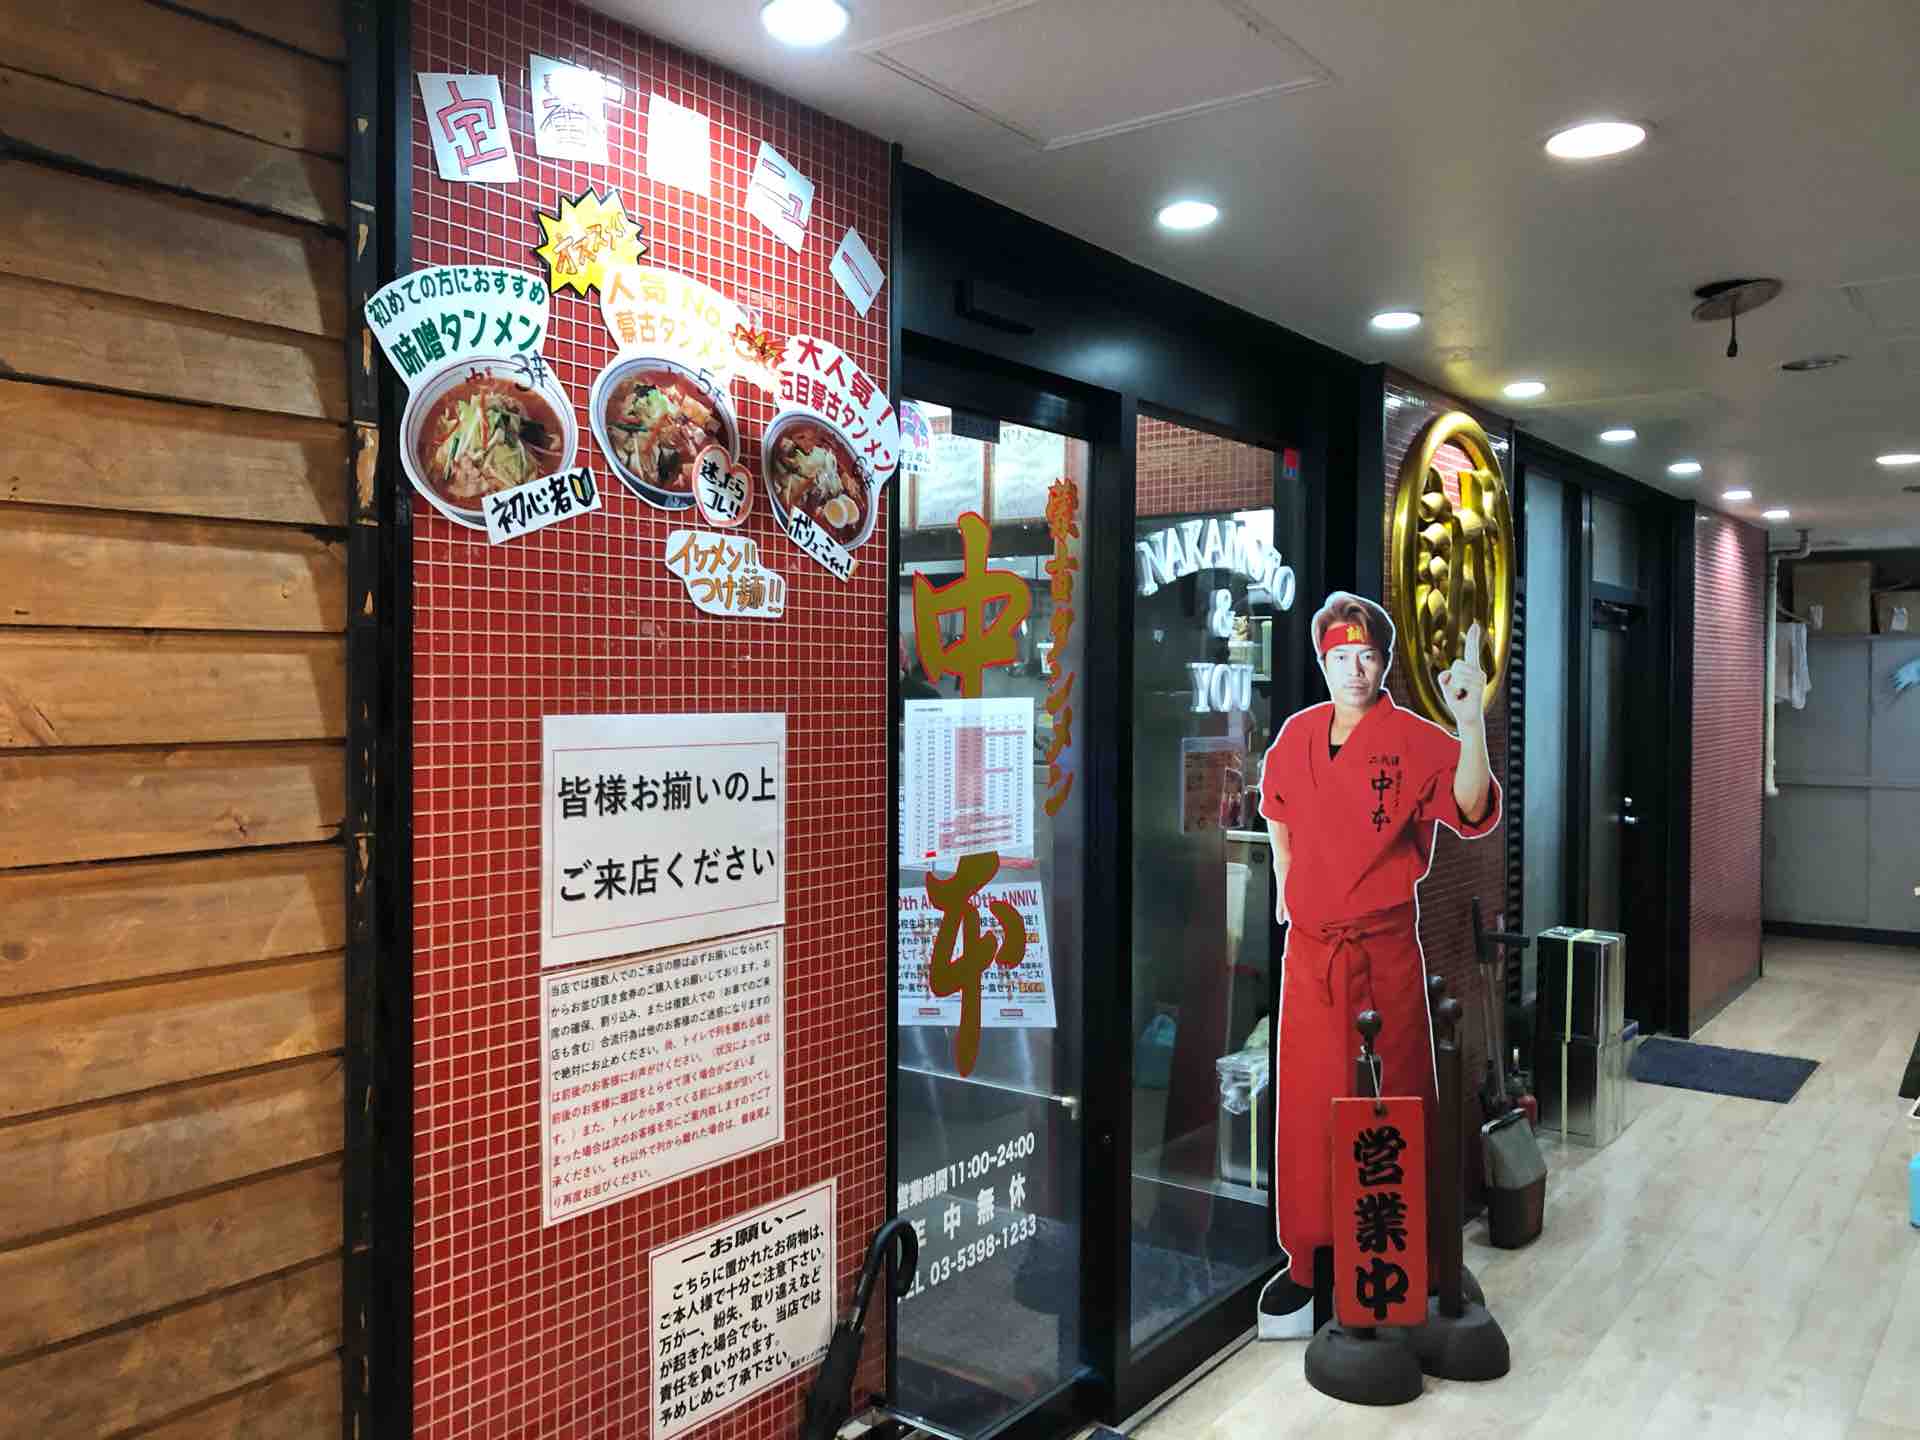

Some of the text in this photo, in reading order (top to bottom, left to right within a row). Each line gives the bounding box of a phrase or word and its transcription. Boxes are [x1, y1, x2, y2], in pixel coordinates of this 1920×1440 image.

[367, 268, 546, 329] 初めての方におすすめ
[390, 309, 542, 378] 味噌タンメン
[491, 476, 572, 534] 初心者
[1208, 588, 1236, 638] &
[1187, 662, 1254, 712] YOU
[557, 766, 776, 819] 皆様お揃いの上
[561, 846, 774, 902] ご来店ください
[930, 1214, 1036, 1286] 03-5398-1233
[1353, 1125, 1409, 1321] 営業中
[660, 1248, 825, 1330] ご本人様で十分ご注意下さい。
[673, 1224, 824, 1300] こちらに置かれたお荷物は、
[660, 1289, 821, 1379] が起きた場合でも、当店では
[660, 1333, 780, 1405] 責任を負いかねます。
